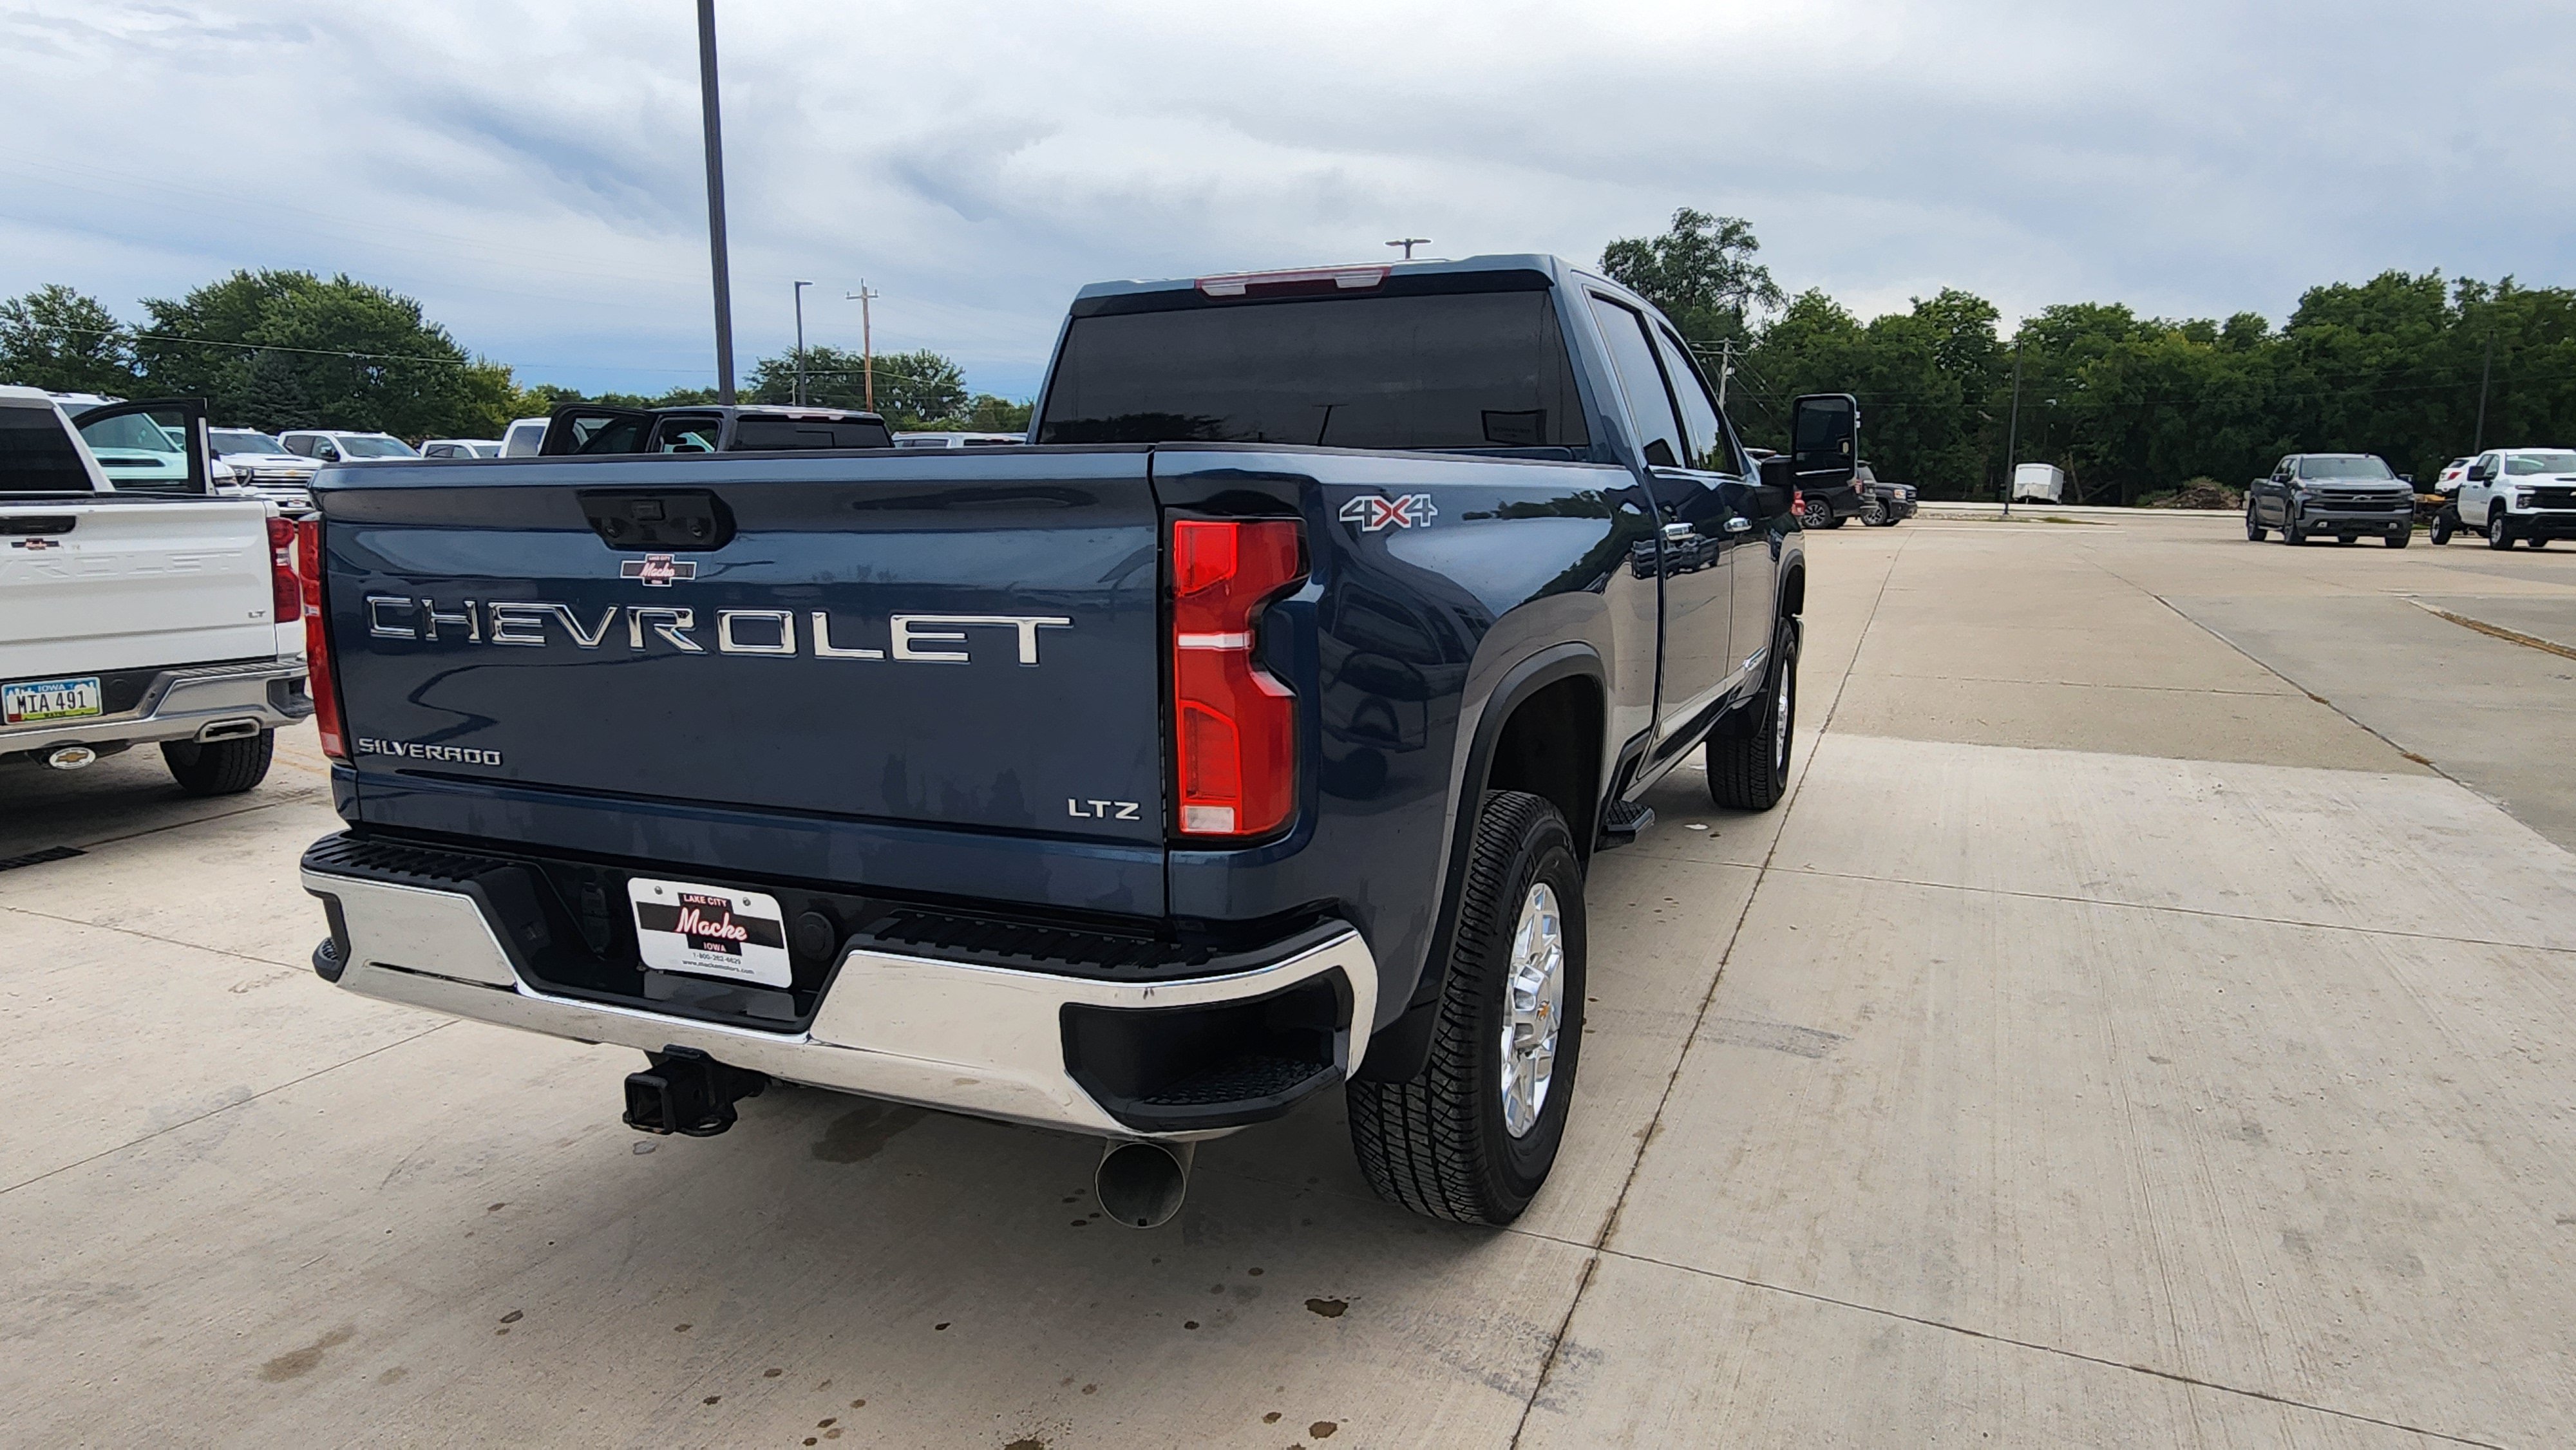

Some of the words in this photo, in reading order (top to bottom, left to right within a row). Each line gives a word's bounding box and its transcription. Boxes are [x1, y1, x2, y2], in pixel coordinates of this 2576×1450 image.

[640, 562, 674, 577] Macke
[366, 596, 1072, 666] CHEVROLET
[17, 693, 50, 713] MIA
[55, 690, 86, 710] 491
[359, 738, 500, 765] SILVERADO
[1068, 798, 1140, 820] LTZ
[683, 894, 706, 903] LAKE
[708, 897, 726, 907] CITY
[676, 907, 748, 941] Macke
[703, 942, 726, 952] IOWA
